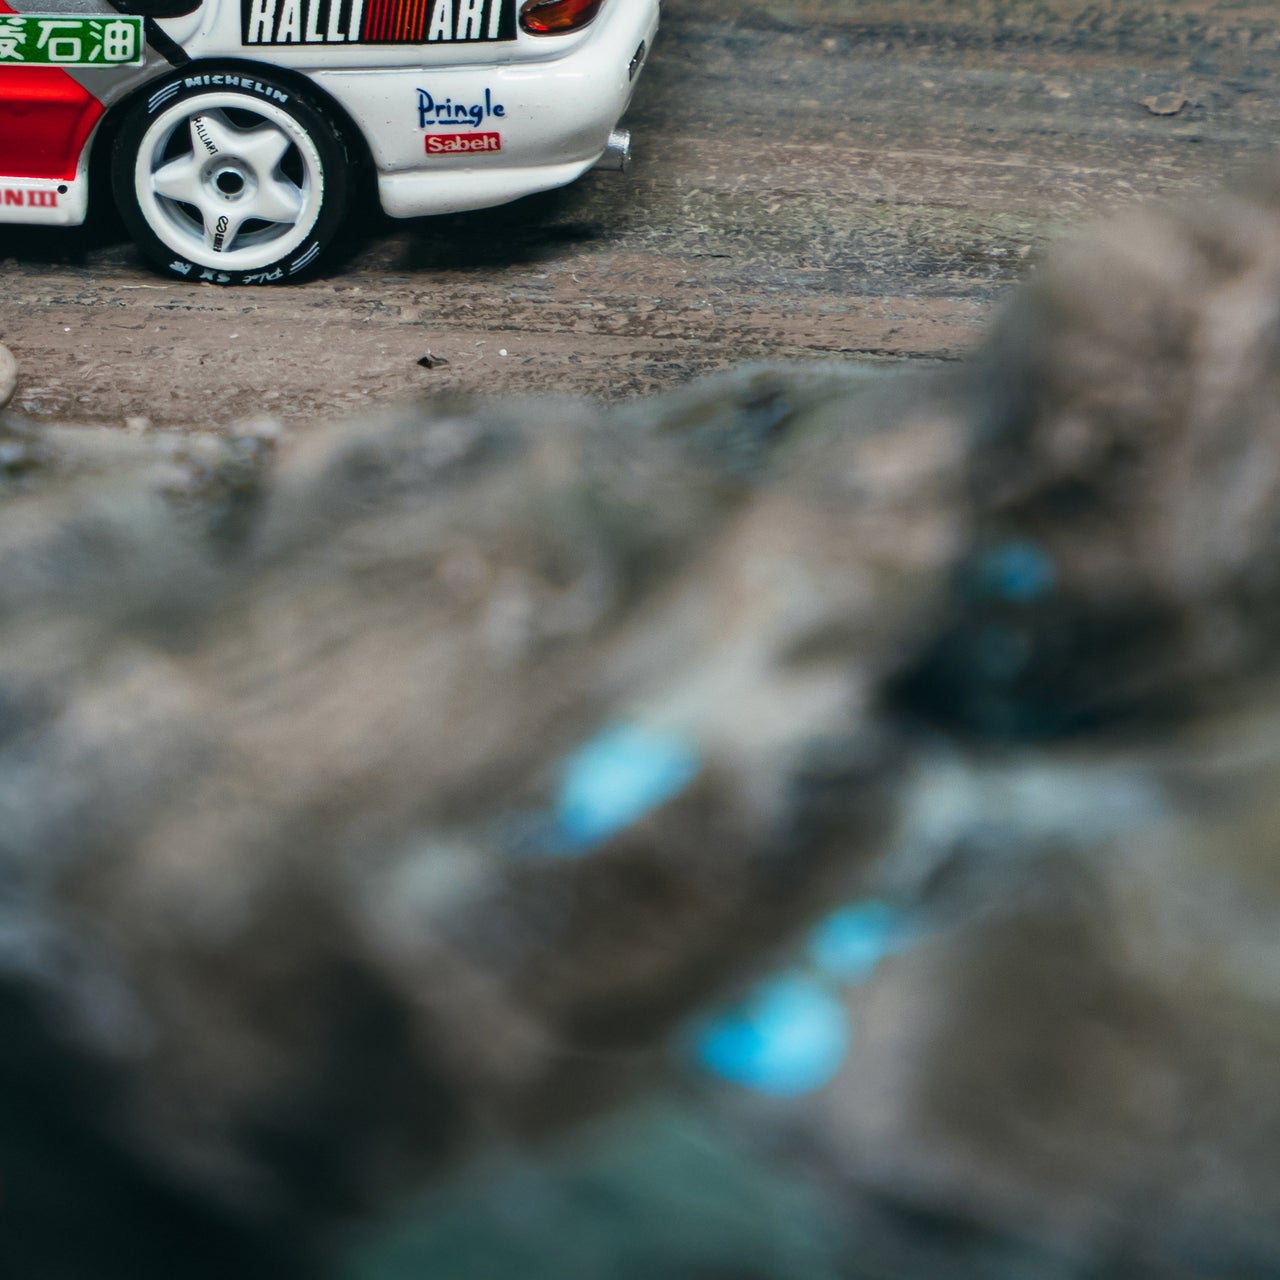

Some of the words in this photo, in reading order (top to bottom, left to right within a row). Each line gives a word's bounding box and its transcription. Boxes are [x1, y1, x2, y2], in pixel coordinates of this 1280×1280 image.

[184, 75, 289, 104] MICHELIN
[415, 87, 506, 129] Pringle
[192, 117, 219, 156] RALLIART
[427, 135, 499, 153] Sabelt
